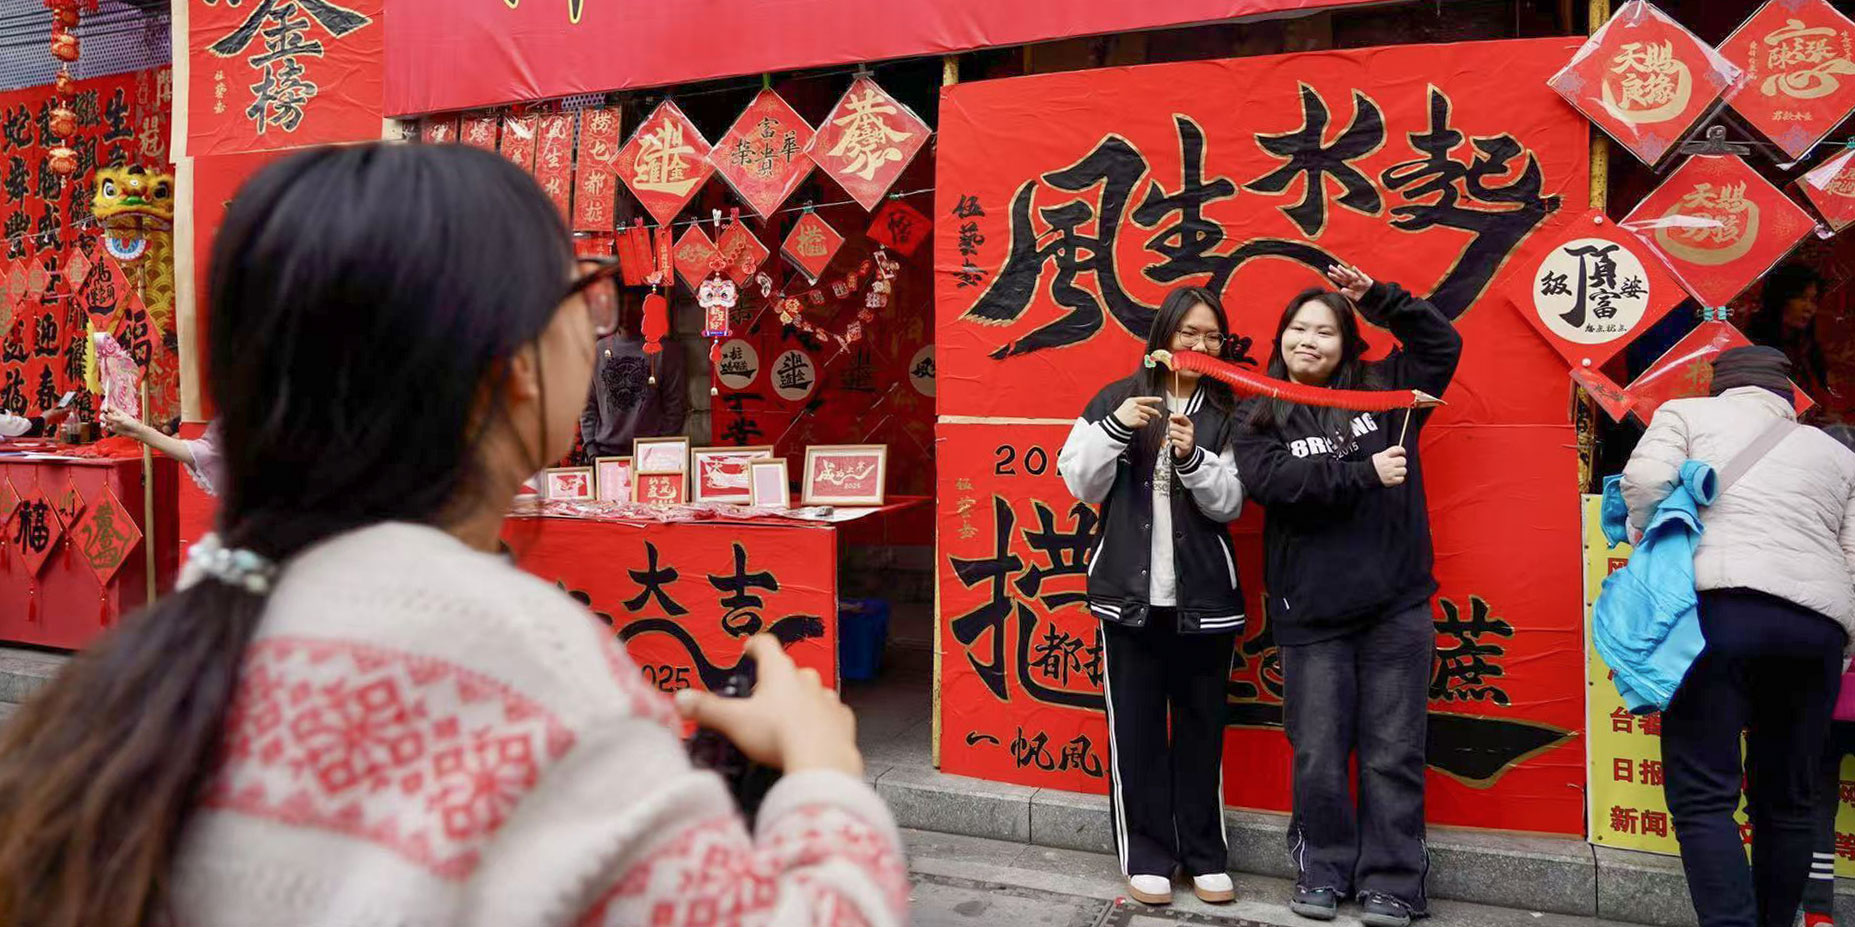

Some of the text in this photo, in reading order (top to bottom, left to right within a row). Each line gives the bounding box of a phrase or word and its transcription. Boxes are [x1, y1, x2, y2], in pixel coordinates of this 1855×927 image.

[965, 79, 1561, 360] 風生水起
[1540, 272, 1572, 297] 級
[1620, 276, 1649, 300] 婆
